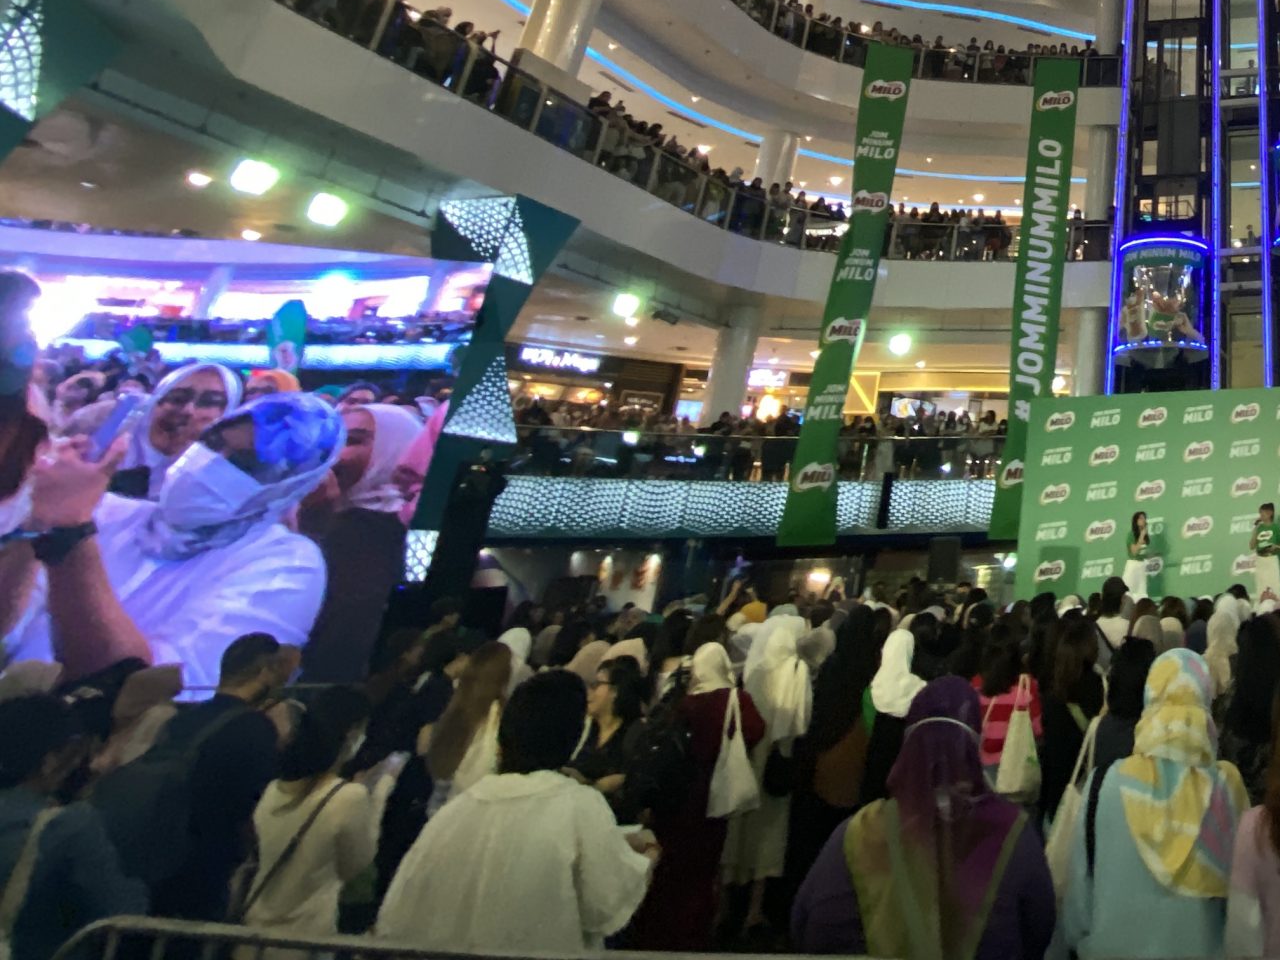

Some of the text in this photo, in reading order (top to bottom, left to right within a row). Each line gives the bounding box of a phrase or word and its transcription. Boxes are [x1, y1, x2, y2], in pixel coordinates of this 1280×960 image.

[871, 84, 903, 96] MILO
[1041, 96, 1071, 107] MILO
[856, 146, 896, 160] MILO
[853, 196, 885, 208] MILO
[836, 266, 875, 282] MILO
[806, 406, 842, 421] MIL
[1182, 409, 1213, 424] MILO
[1090, 414, 1121, 428] MILO
[1135, 448, 1166, 462] MILO
[1229, 444, 1260, 458] MILO
[1041, 452, 1072, 467] MILO
[1004, 467, 1024, 481] MI
[1086, 487, 1117, 501] MILO
[1181, 483, 1213, 498] MILO
[1036, 526, 1068, 541] MILO
[1081, 564, 1114, 579] MILO
[1180, 561, 1213, 576] MILO
